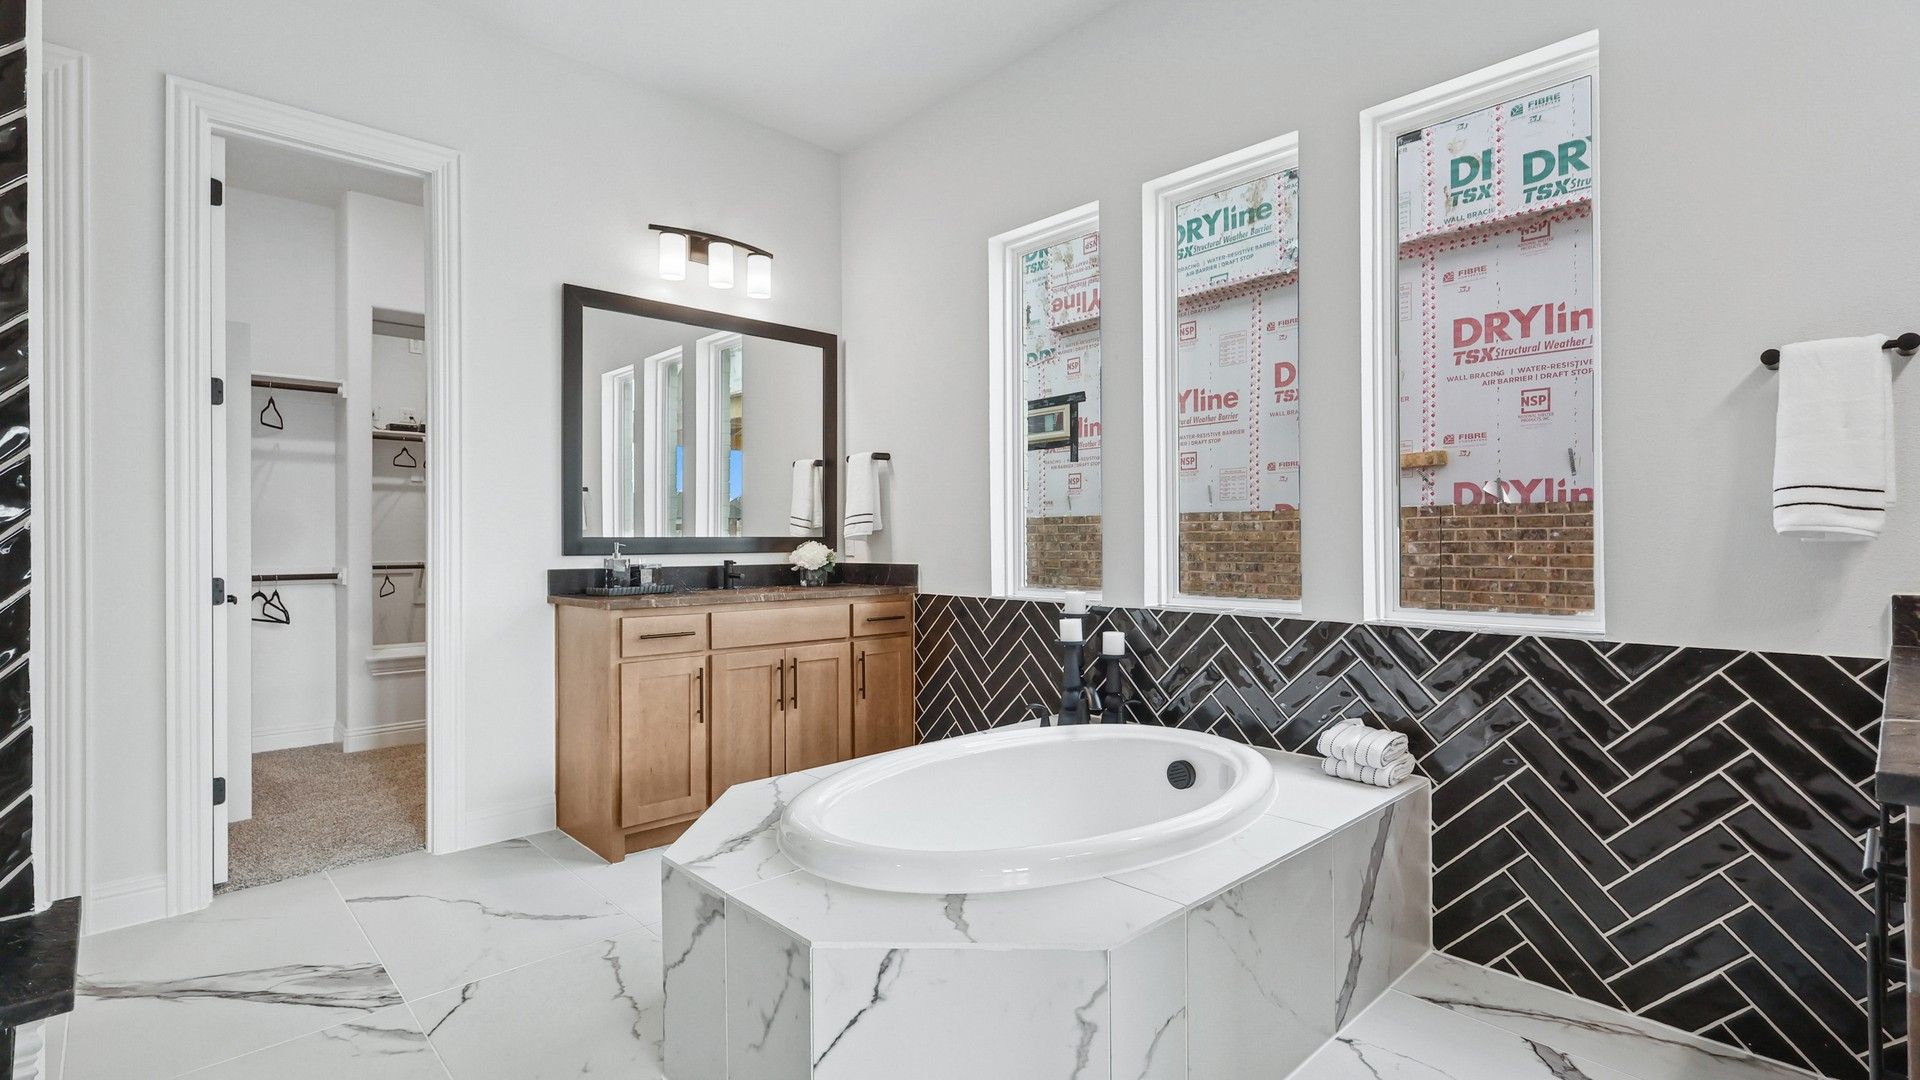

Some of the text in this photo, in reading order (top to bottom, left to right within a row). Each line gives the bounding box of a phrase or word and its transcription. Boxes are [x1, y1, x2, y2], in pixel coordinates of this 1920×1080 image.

[1528, 92, 1560, 108] FIBRE
[1523, 136, 1592, 185] DR
[1450, 183, 1492, 207] TSX
[1523, 178, 1570, 204] TSX
[1444, 214, 1465, 224] WALL
[1223, 230, 1248, 244] Weather
[1250, 224, 1272, 236] Barrier
[1458, 265, 1487, 277] FIBRE
[1180, 326, 1194, 337] NSP
[1453, 302, 1594, 348] DRYlin
[1453, 347, 1496, 366] TSX
[1494, 342, 1540, 359] Structural
[1544, 337, 1586, 350] Weather
[1446, 374, 1468, 382] WALL
[1470, 370, 1505, 380] BRACING
[1497, 375, 1533, 385] BARRIER
[1540, 370, 1568, 380] DRAFT
[1521, 394, 1546, 407] NSP
[1458, 432, 1488, 440] FIBRE
[1180, 456, 1194, 466] NSP
